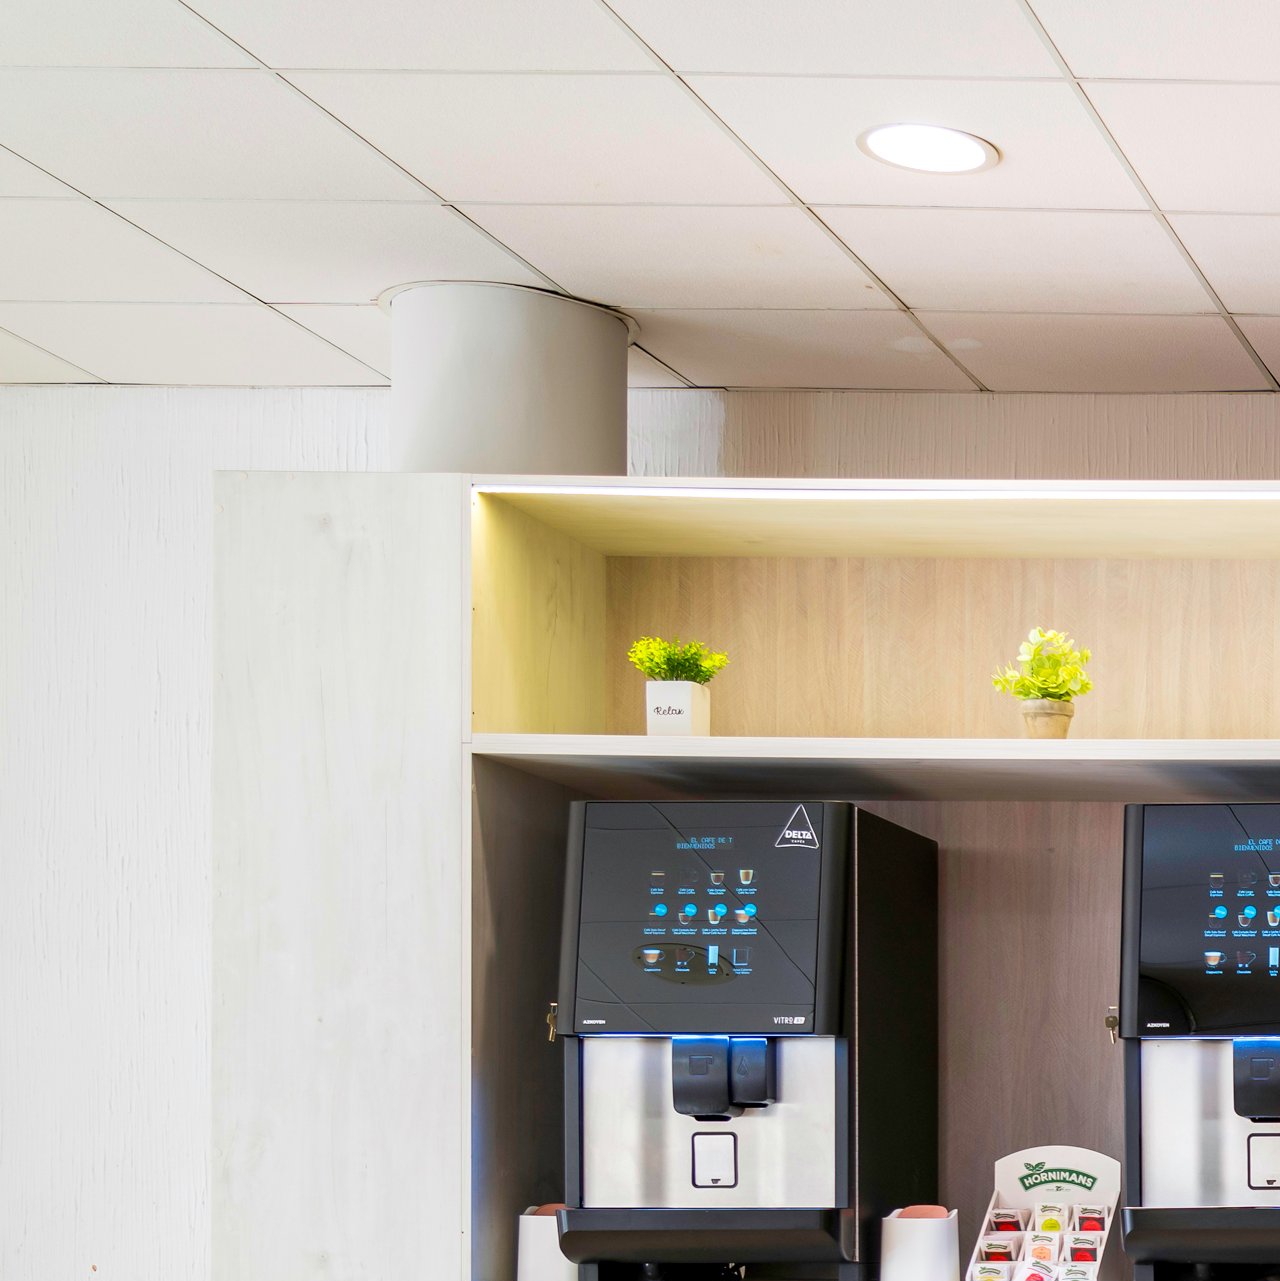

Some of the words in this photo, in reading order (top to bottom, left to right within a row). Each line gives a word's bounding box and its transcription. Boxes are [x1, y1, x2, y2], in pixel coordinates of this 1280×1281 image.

[653, 705, 684, 716] Relax
[785, 830, 812, 840] DELTA
[773, 1016, 794, 1025] VITRO
[1023, 1171, 1094, 1188] HORNIMANS
